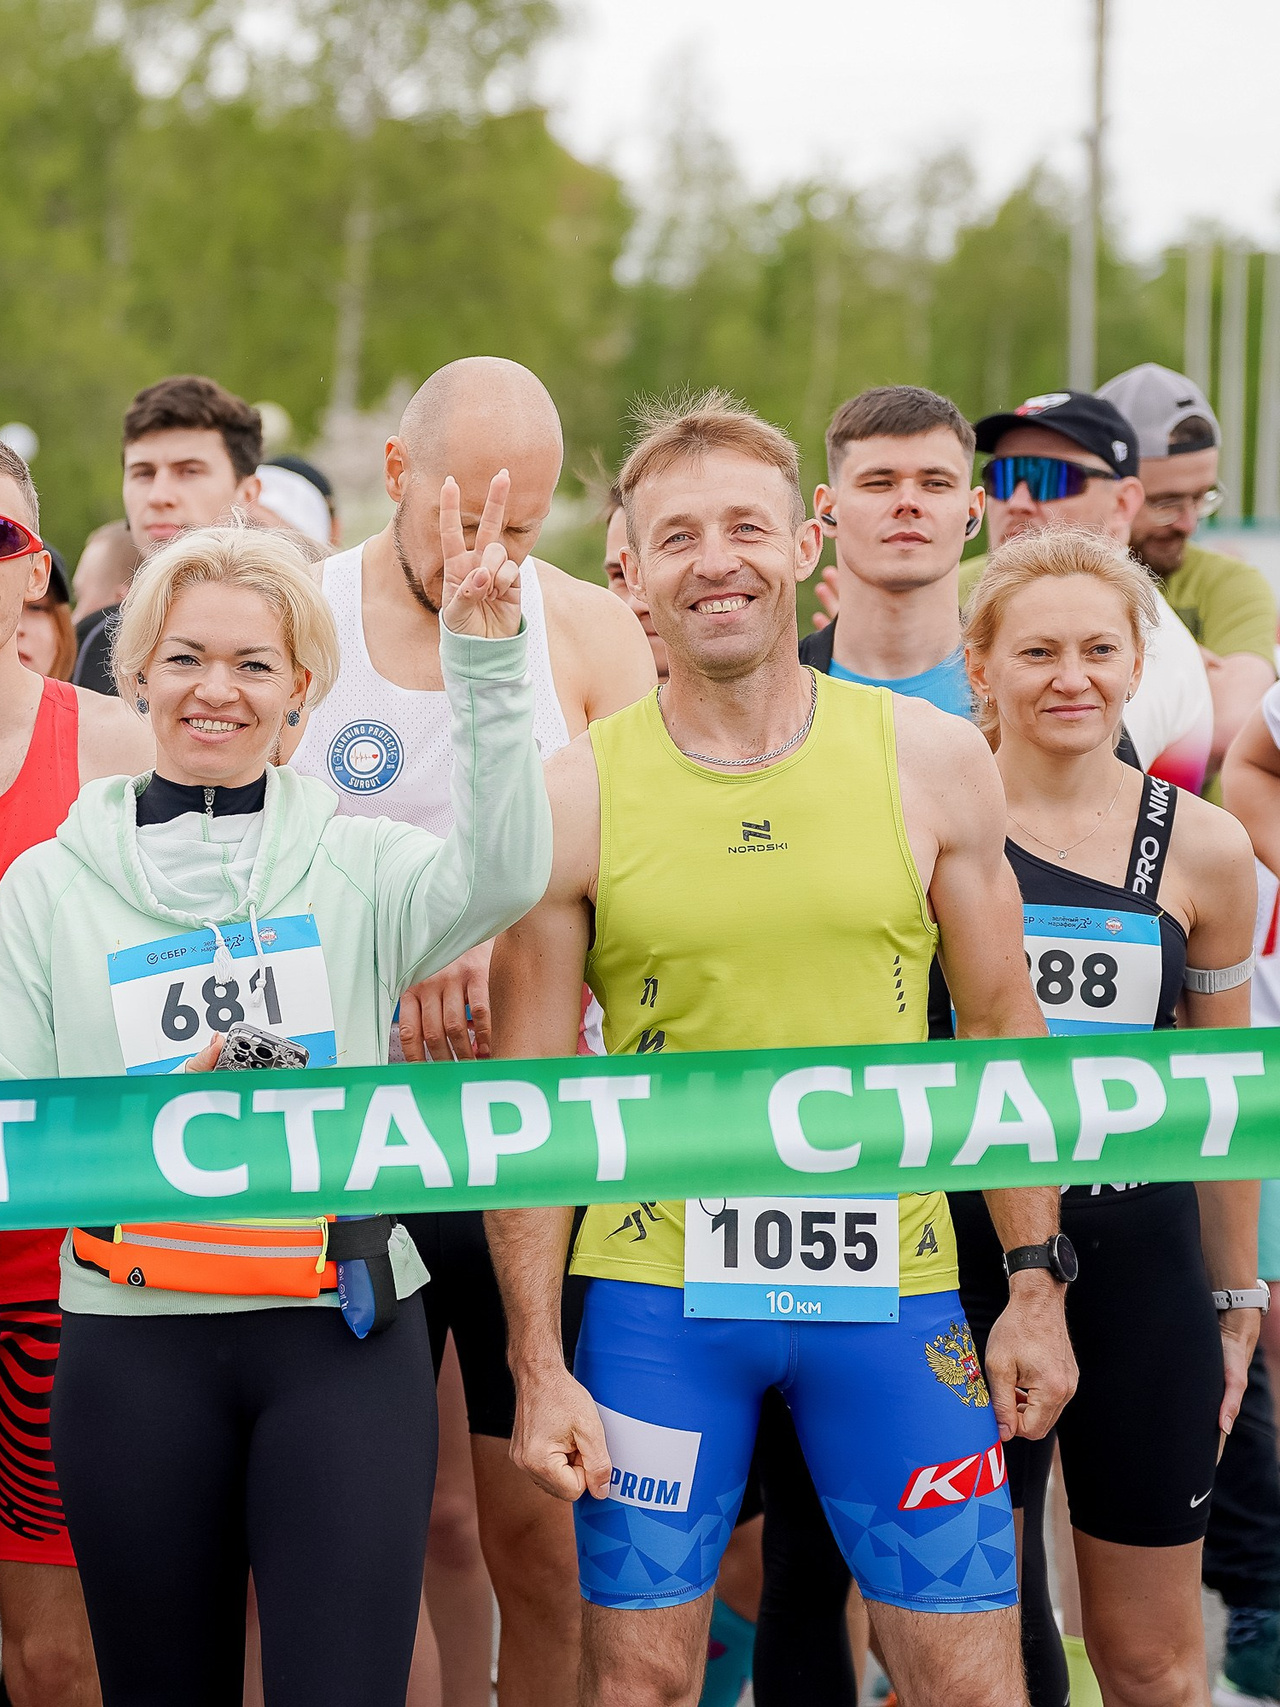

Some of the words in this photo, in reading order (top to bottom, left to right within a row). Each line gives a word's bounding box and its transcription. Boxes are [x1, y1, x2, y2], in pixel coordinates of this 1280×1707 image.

[334, 725, 365, 754] RUNNING
[368, 726, 397, 753] PROJECT
[348, 776, 381, 789] SURGUT
[728, 842, 788, 854] NORDSKI
[1132, 836, 1160, 895] PRO
[160, 947, 187, 960] СБЕР
[1024, 949, 1119, 1008] 88
[161, 966, 283, 1042] 681
[151, 1074, 652, 1198] СТАРТ
[767, 1050, 1266, 1174] СТАРТ
[712, 1208, 878, 1272] 1055
[610, 1466, 682, 1506] PROM
